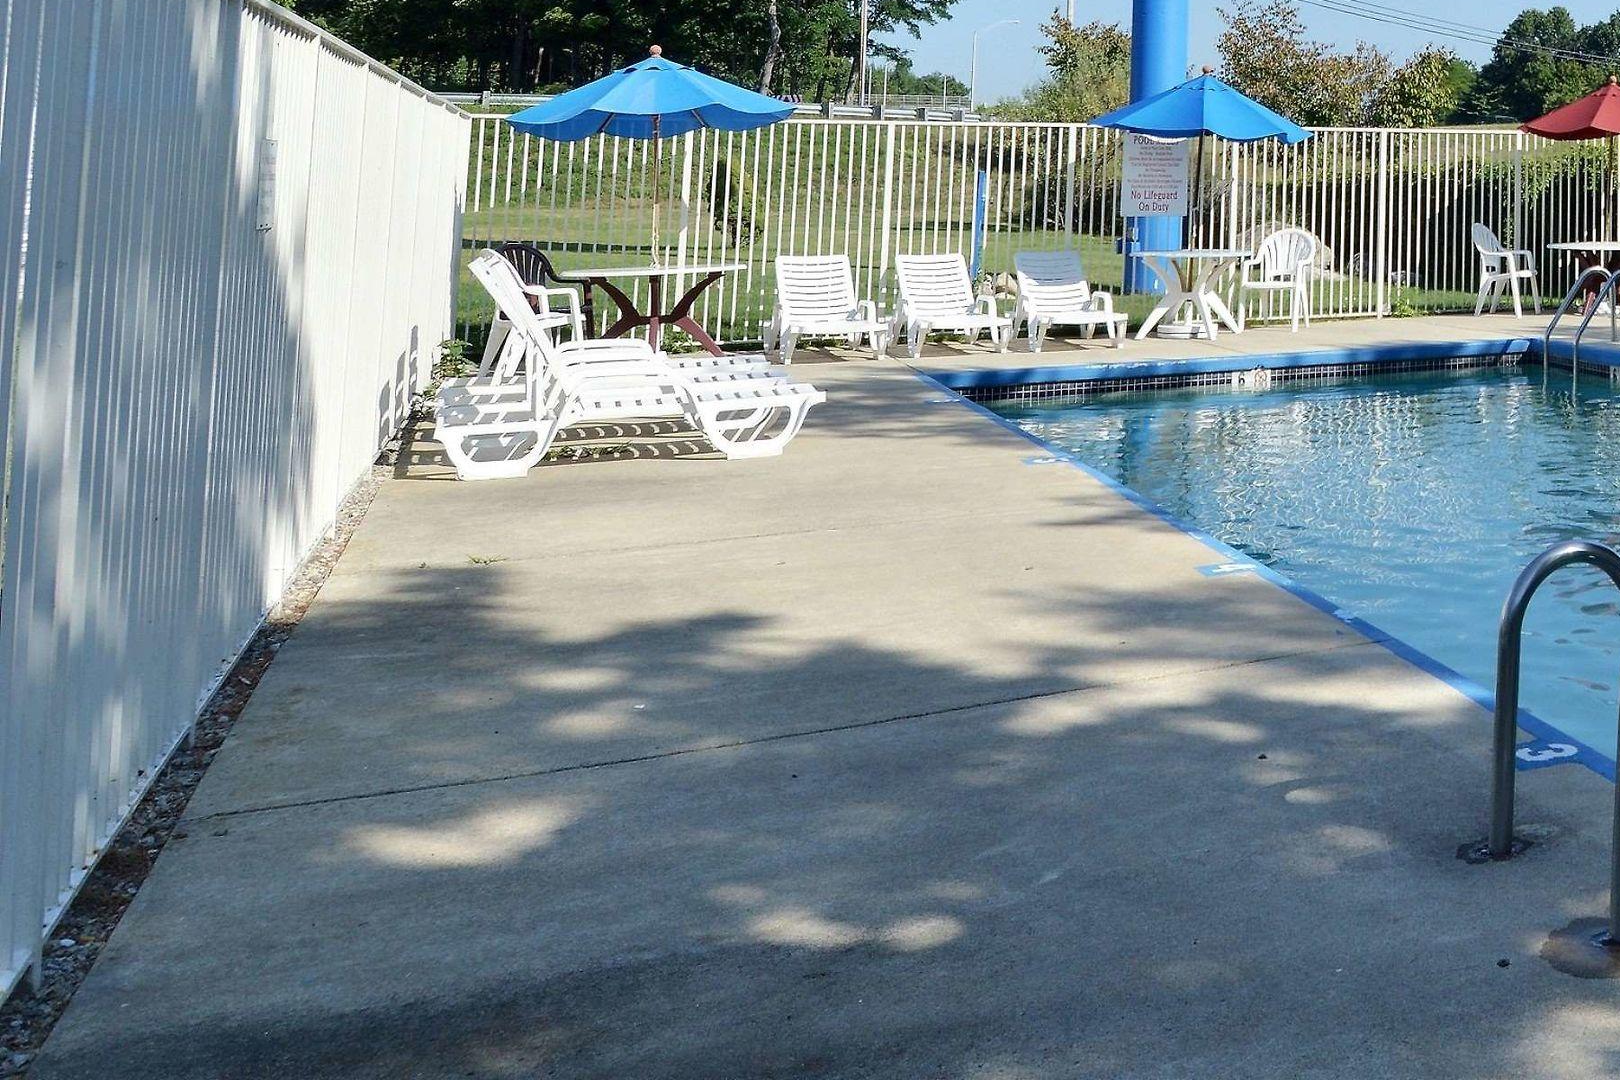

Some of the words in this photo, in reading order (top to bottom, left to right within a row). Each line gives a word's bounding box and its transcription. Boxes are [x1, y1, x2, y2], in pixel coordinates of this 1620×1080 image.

[1131, 190, 1141, 199] No
[1144, 190, 1178, 201] Lifeguard
[1138, 202, 1149, 211] On
[1153, 203, 1169, 212] Duty
